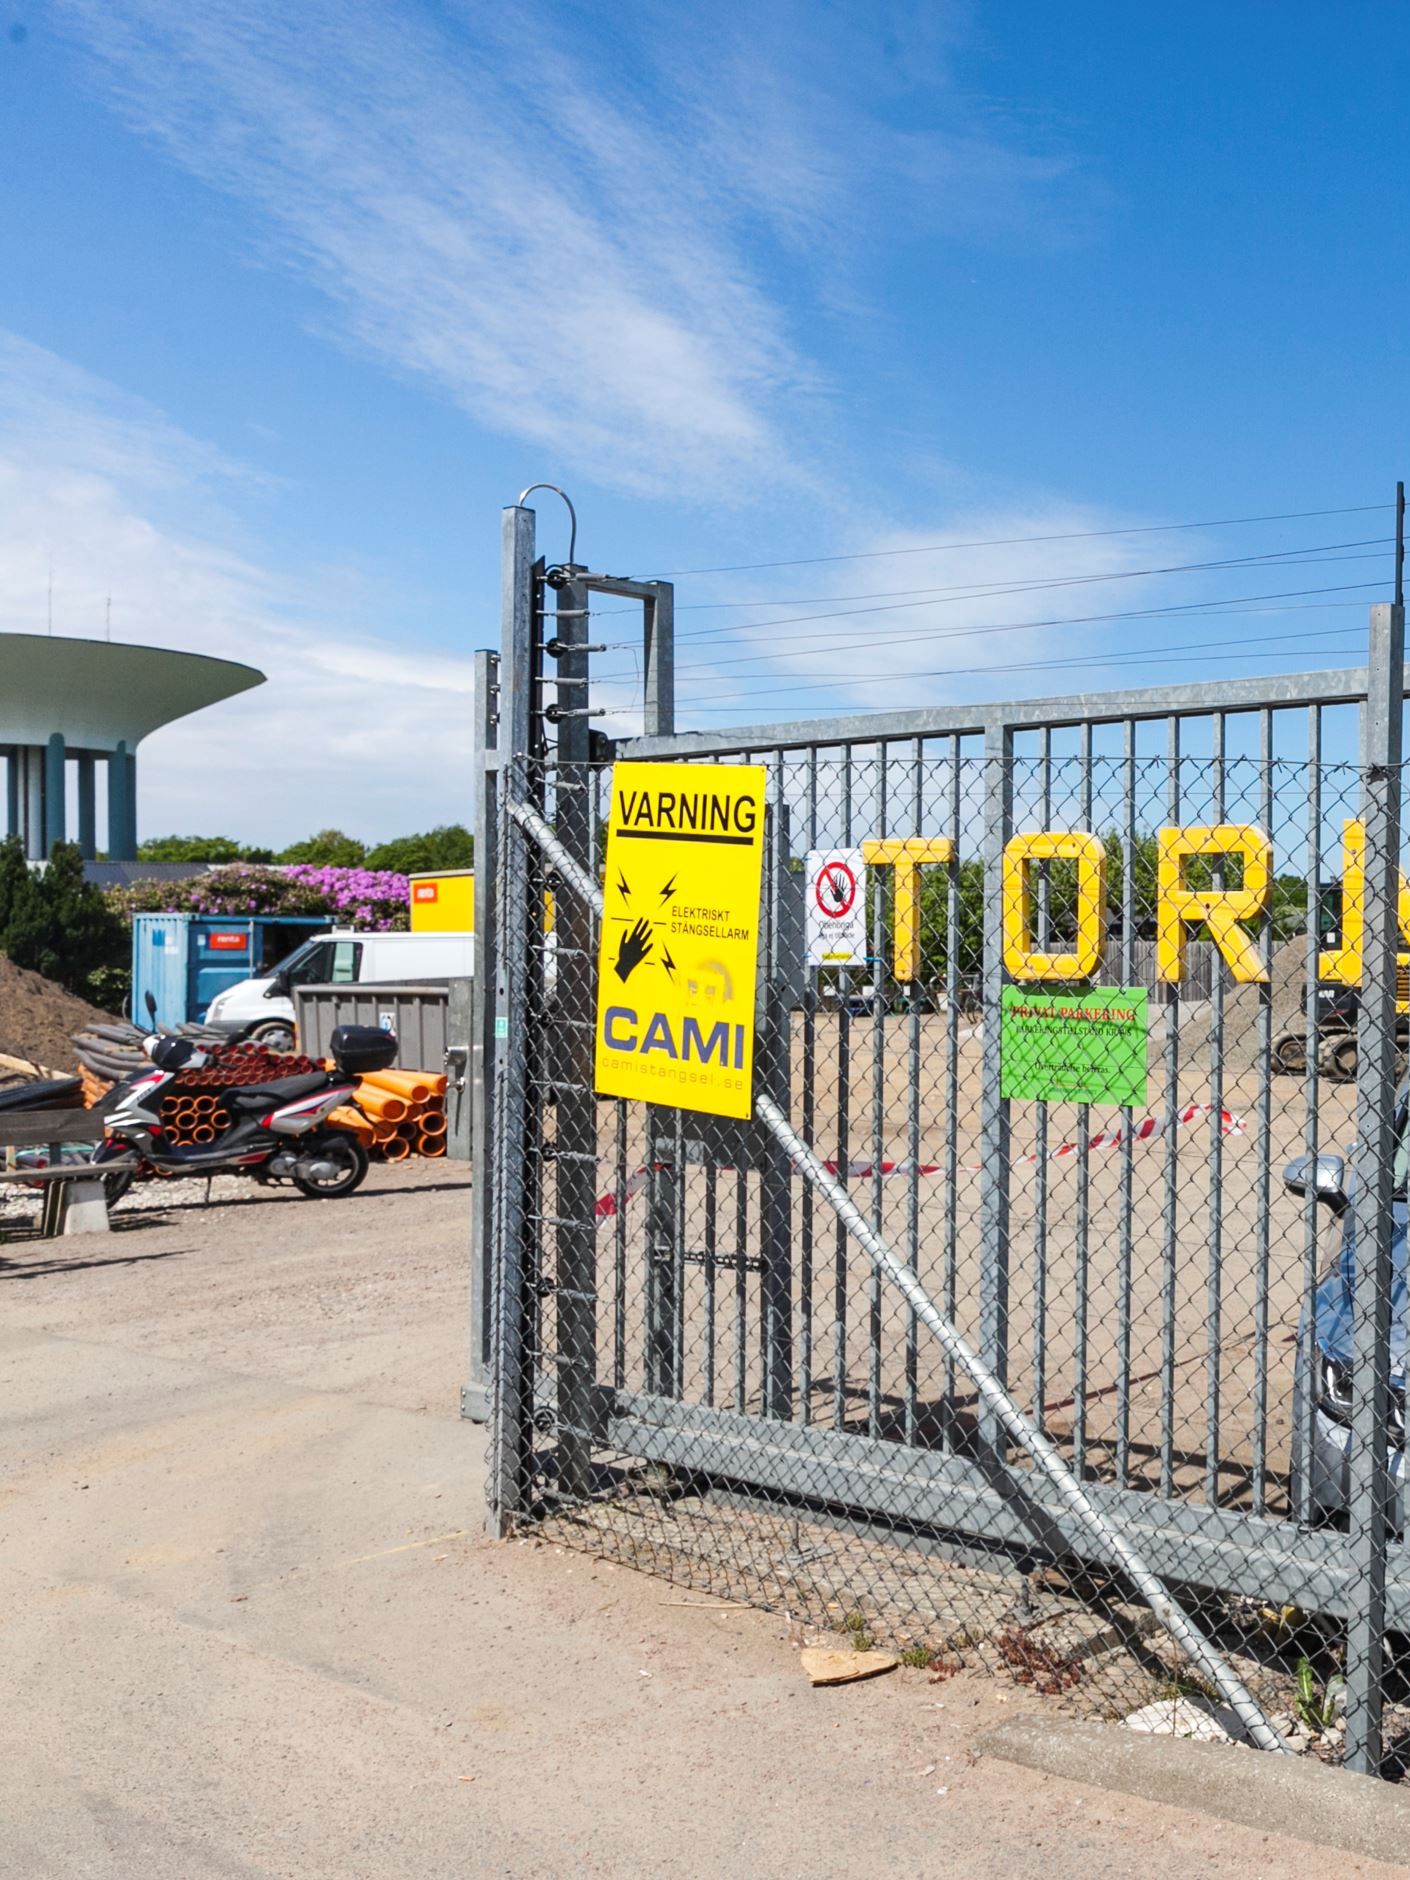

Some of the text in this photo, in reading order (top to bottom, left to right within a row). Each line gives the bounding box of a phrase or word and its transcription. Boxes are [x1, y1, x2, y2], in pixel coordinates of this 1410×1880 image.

[619, 790, 756, 833] VARNING
[671, 905, 730, 922] ELEKTRISKT
[671, 922, 750, 940] STÄNGSELLARM
[1011, 1005, 1136, 1022] PRIVAT PARKERING
[604, 1006, 744, 1069] CAMI
[602, 1057, 743, 1090] camistangsel.se
